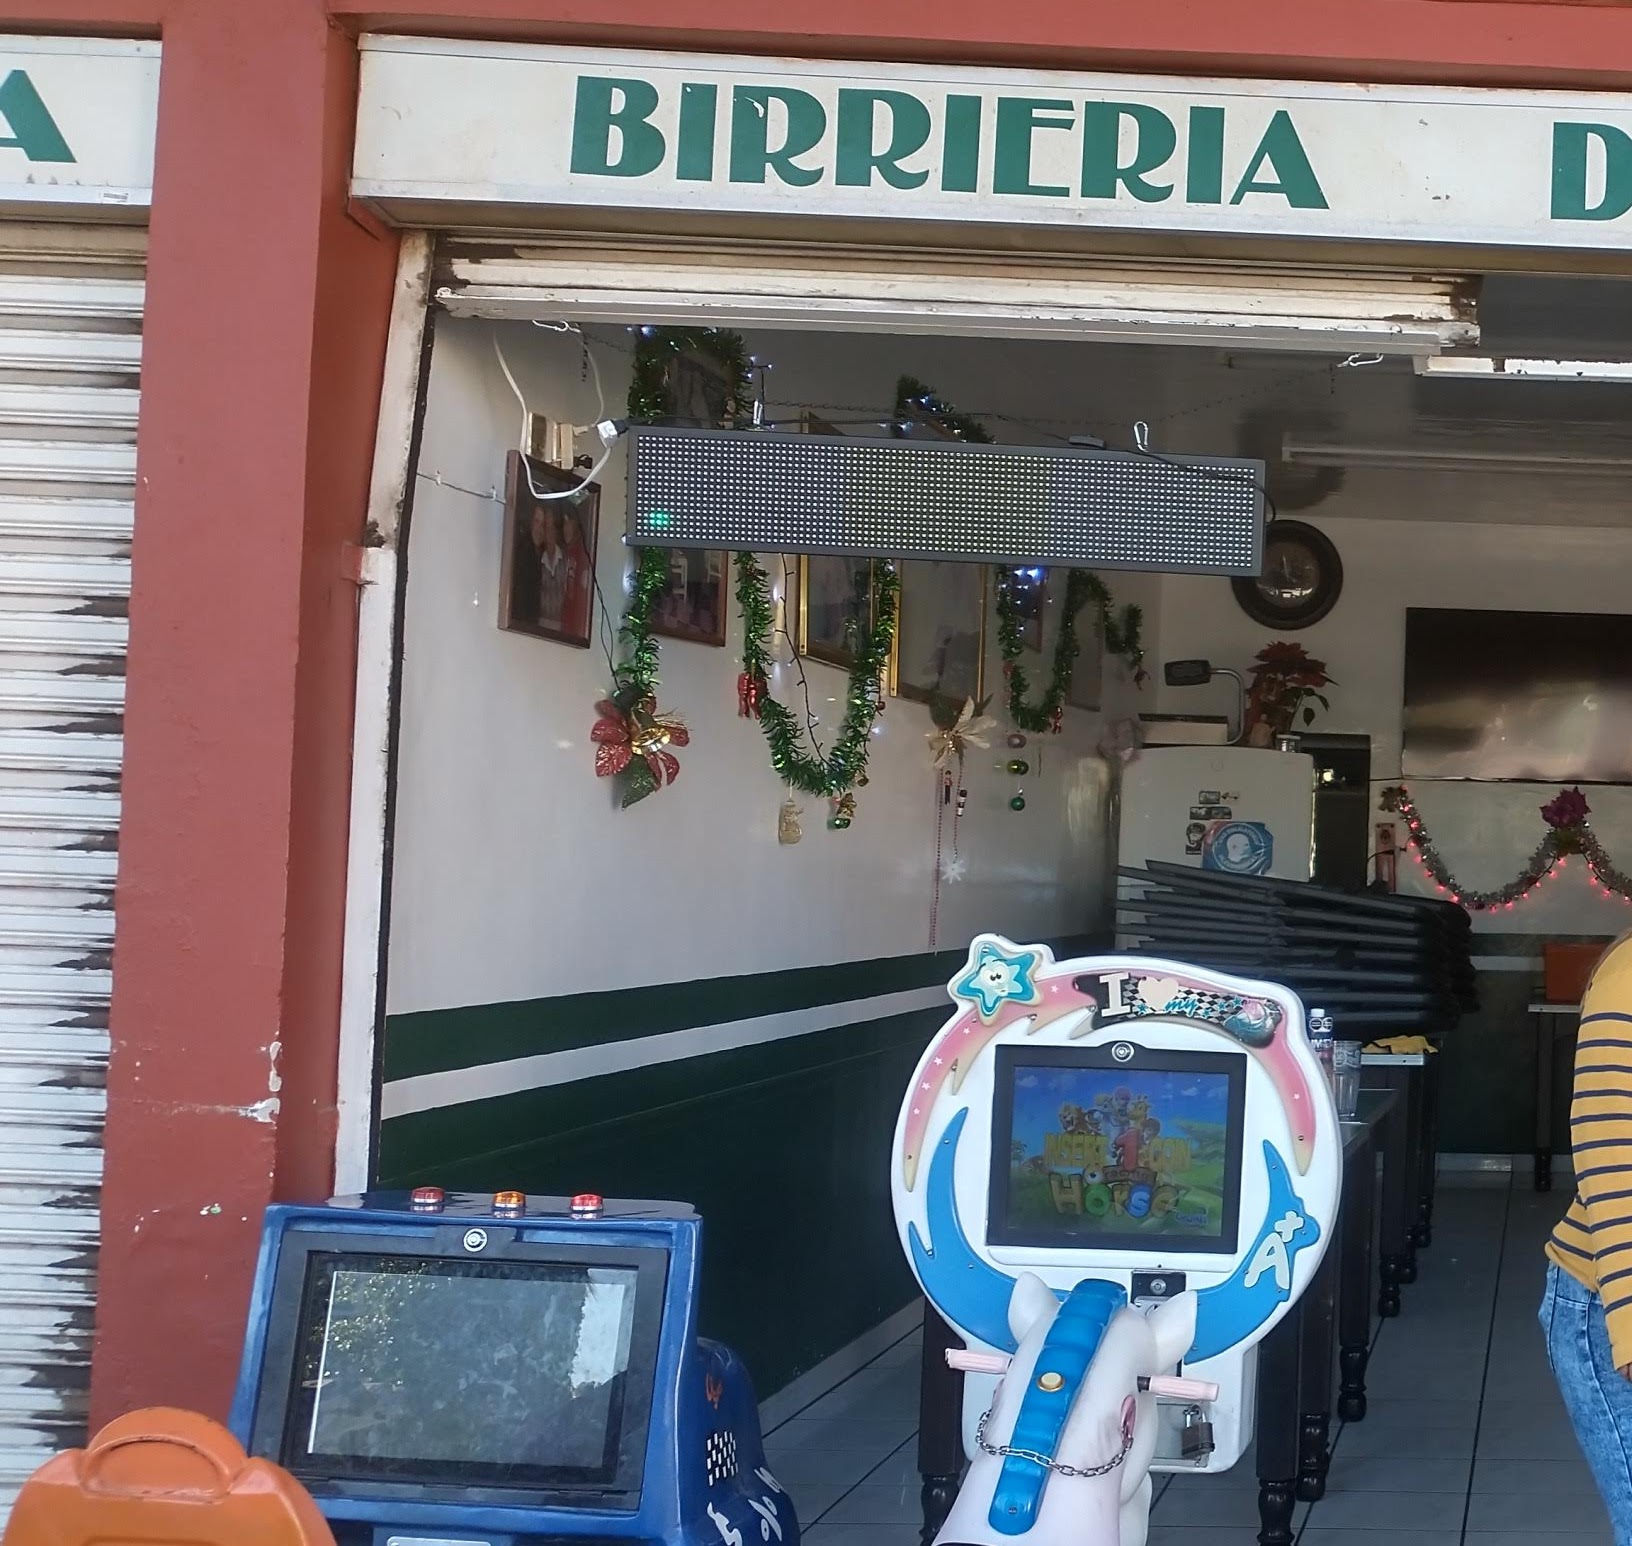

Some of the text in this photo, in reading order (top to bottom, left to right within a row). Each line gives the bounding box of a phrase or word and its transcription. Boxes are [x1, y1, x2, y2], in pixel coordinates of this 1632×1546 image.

[0, 69, 76, 163] A
[570, 76, 1328, 209] BIRRIERIA
[1163, 998, 1199, 1019] my
